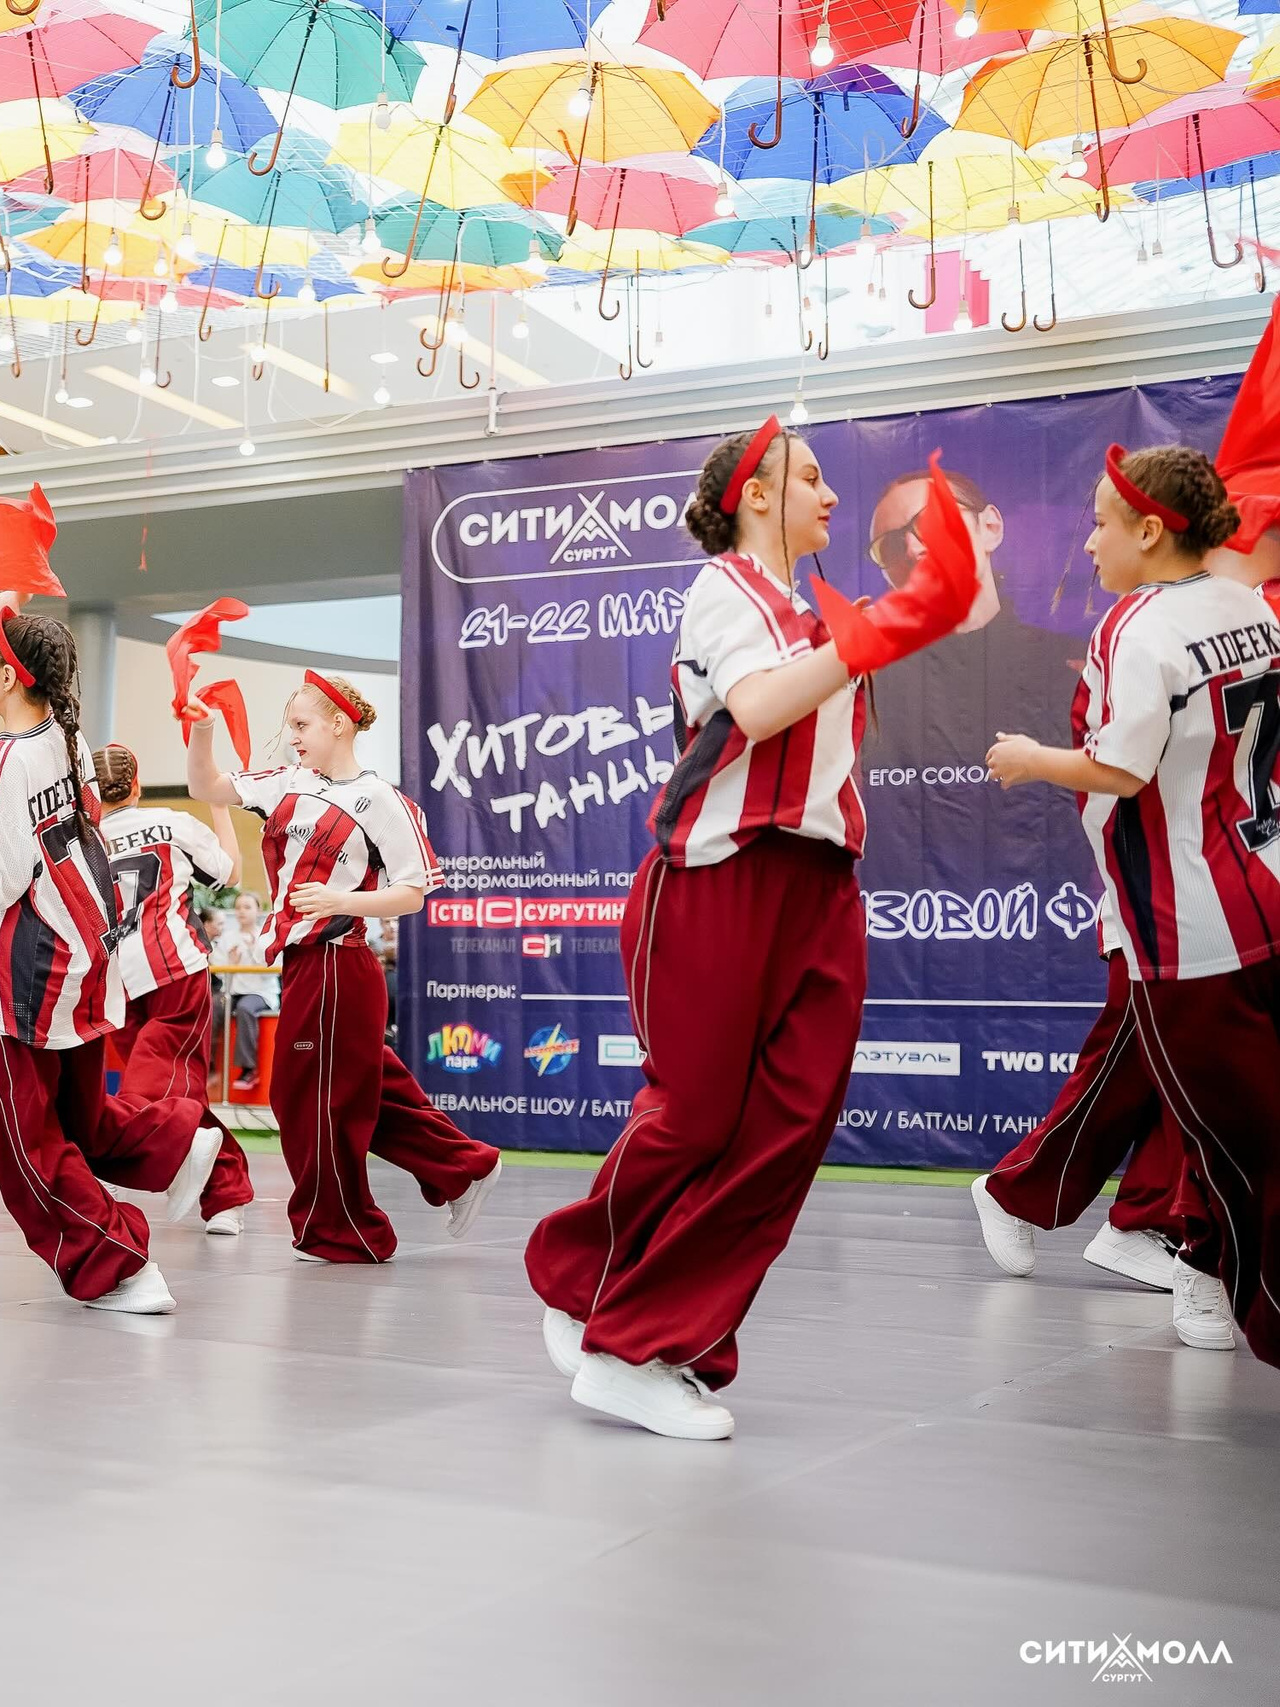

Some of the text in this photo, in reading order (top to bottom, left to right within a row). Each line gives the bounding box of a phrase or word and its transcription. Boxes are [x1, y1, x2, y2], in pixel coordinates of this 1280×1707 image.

[459, 503, 573, 547] СИТИ
[562, 546, 619, 562] СУРГУТ
[458, 586, 692, 650] 21-22 МАР
[870, 768, 917, 786] ЕГОР
[436, 851, 545, 873] енеральный
[439, 869, 600, 892] формационный
[523, 900, 625, 922] СУРГУТИН
[861, 882, 1038, 941] ЗОВОЙ
[571, 937, 620, 954] ТЕЛЕКАН
[426, 980, 517, 1001] Партнеры:
[981, 1050, 1044, 1073] TWO
[428, 1093, 528, 1114] ЦЕВАЛЬНОЕ
[530, 1098, 575, 1116] ШОУ
[897, 1110, 973, 1132] БАТТЛЫ
